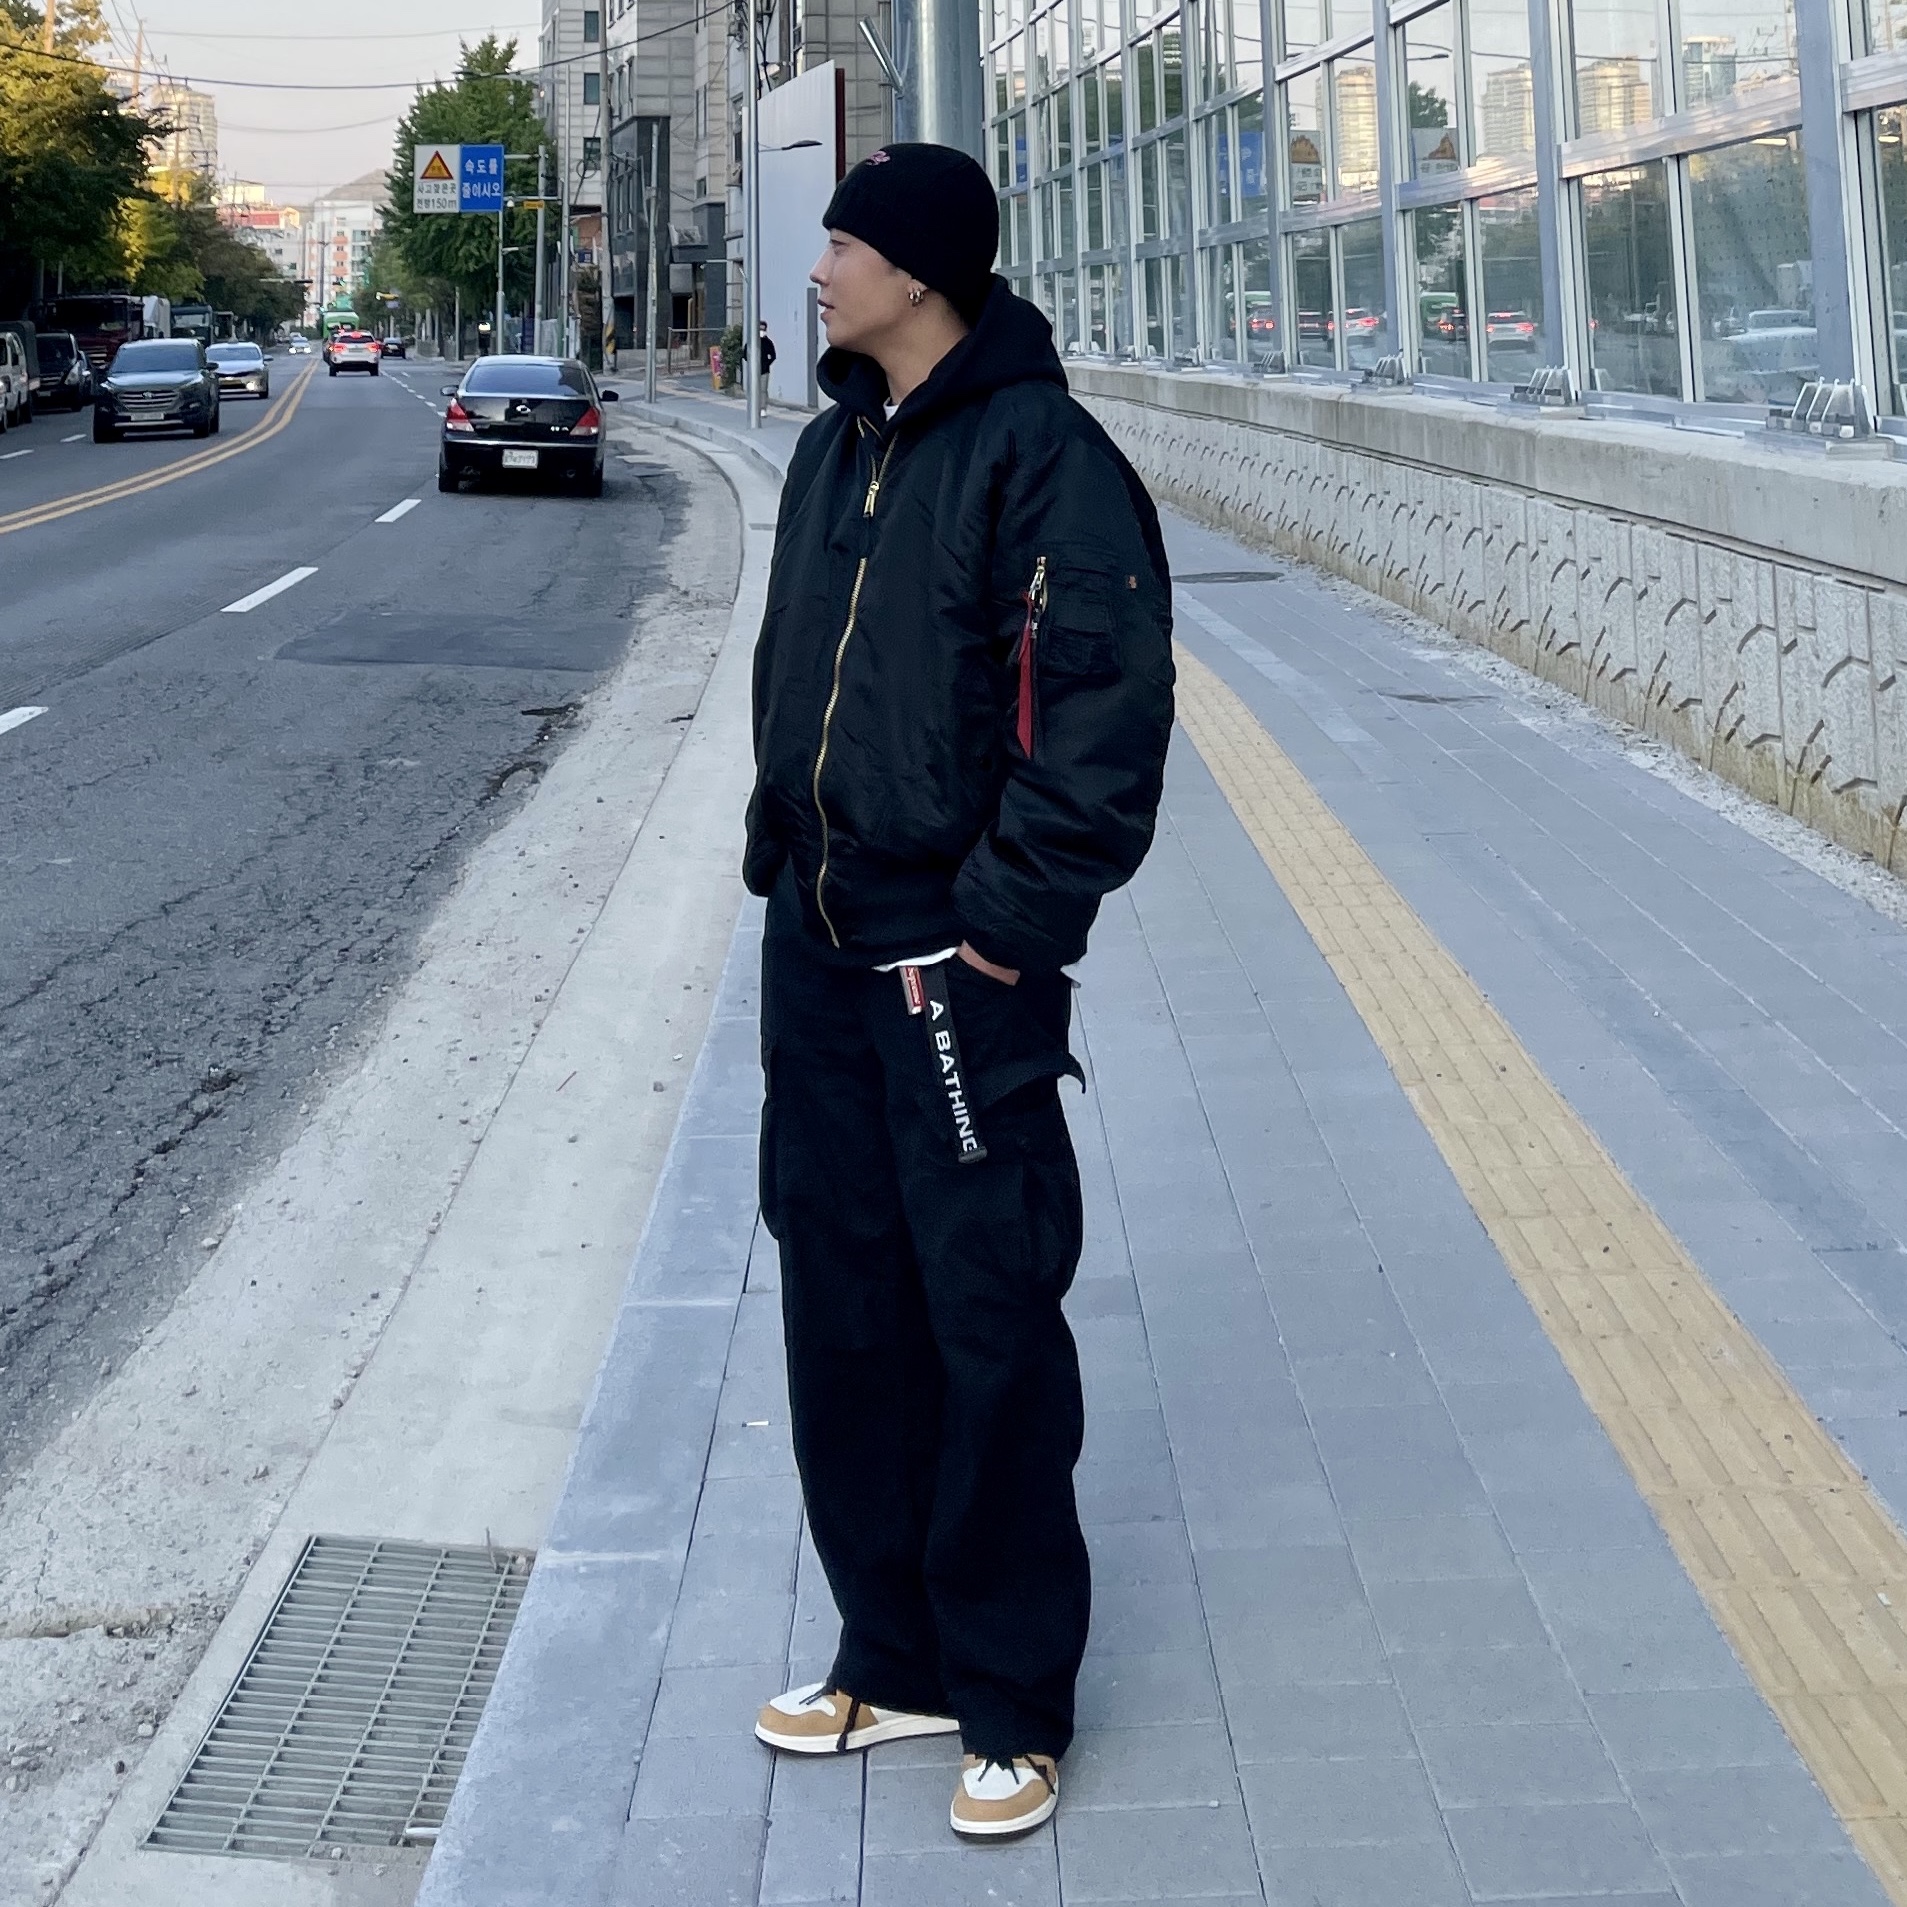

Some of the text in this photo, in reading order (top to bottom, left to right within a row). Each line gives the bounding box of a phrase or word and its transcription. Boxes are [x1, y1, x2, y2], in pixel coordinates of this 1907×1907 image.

[465, 158, 498, 175] 속도를
[462, 182, 501, 199] 줄이시오
[929, 1000, 944, 1021] A
